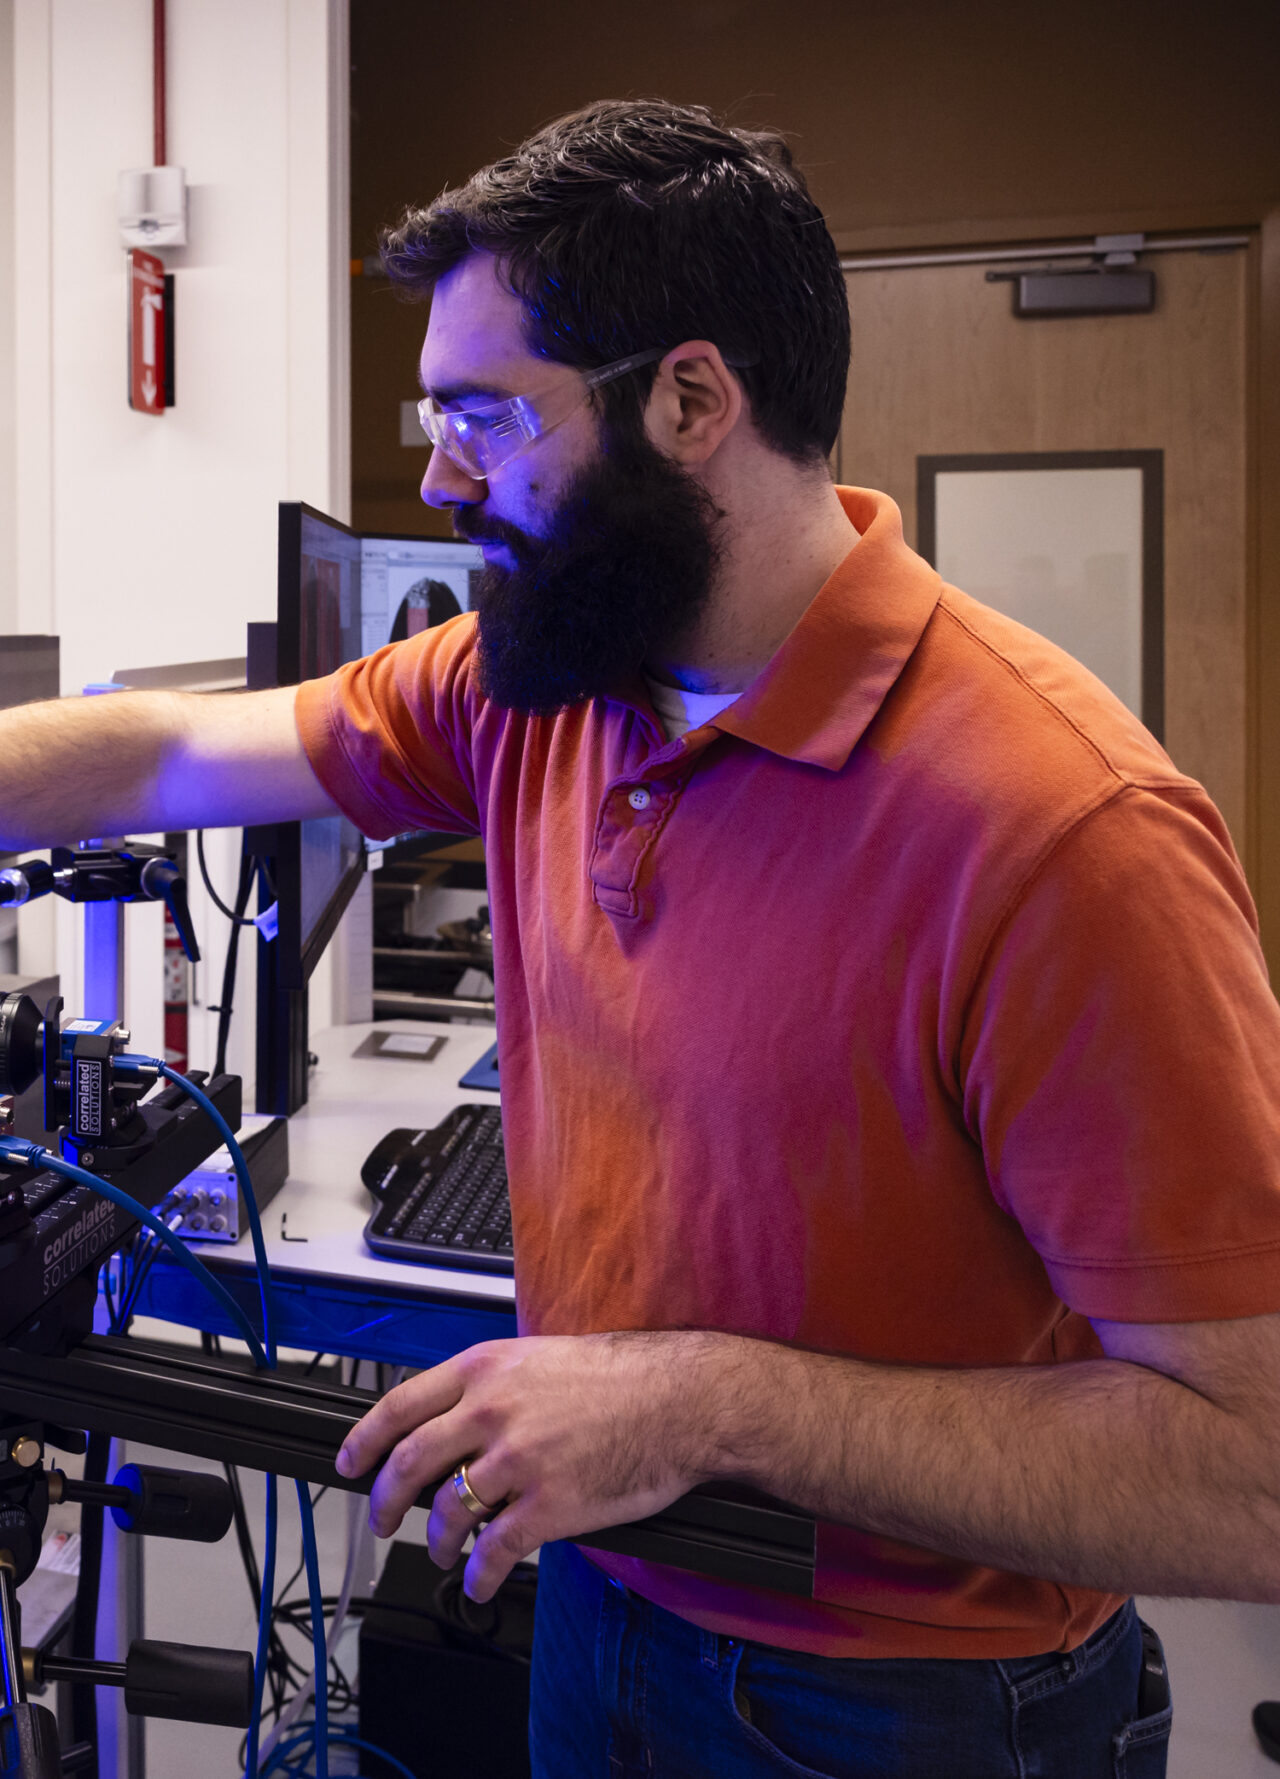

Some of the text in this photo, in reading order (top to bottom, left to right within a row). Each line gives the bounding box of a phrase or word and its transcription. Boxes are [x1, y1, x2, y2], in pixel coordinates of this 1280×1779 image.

[78, 1064, 90, 1131] correlated
[91, 1064, 100, 1133] SOLUTIONS
[43, 1219, 115, 1296] SOLUTIONS
